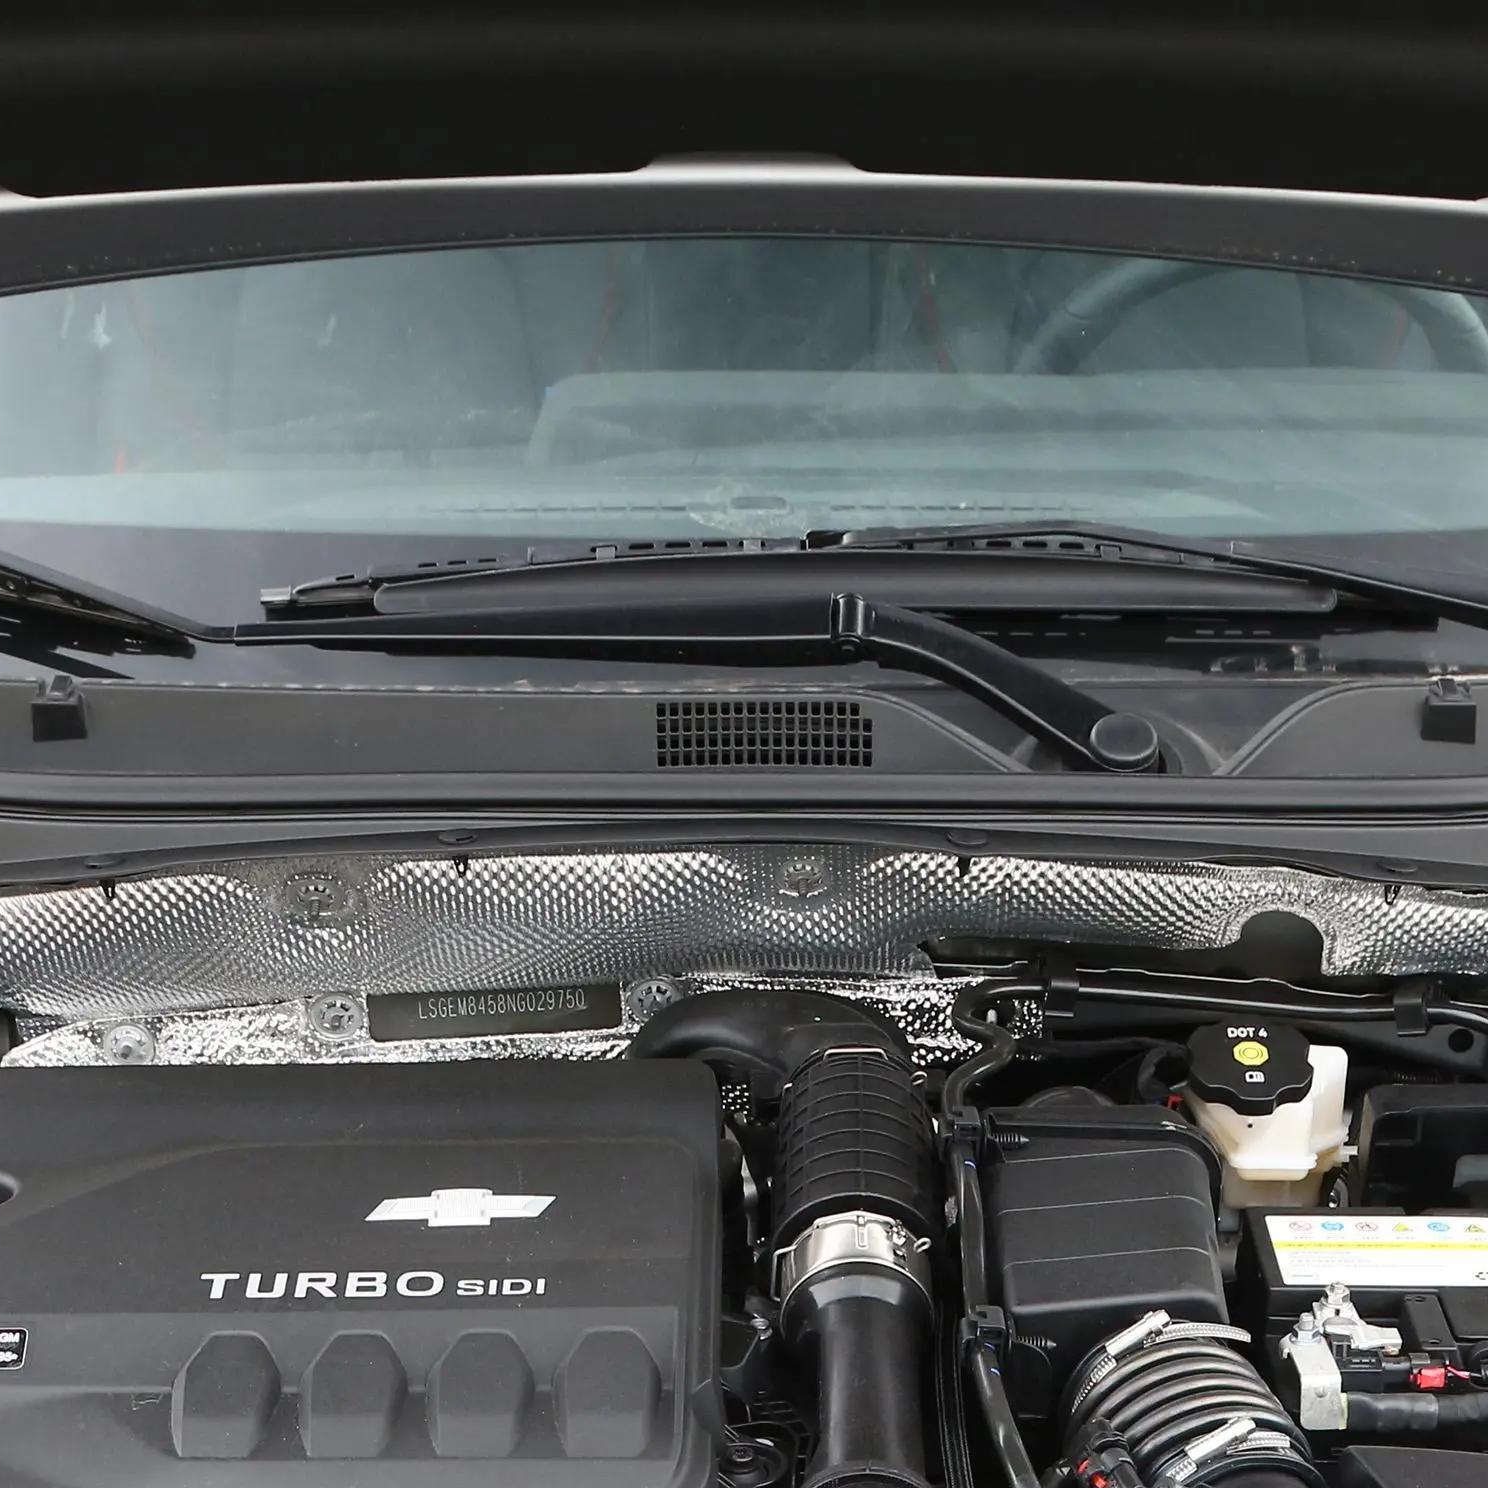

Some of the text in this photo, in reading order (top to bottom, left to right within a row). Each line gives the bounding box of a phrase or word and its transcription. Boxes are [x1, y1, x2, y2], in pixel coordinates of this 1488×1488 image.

[418, 988, 585, 1020] LSGEM8458NG029750
[1227, 1027, 1268, 1038] DOT 4
[200, 1270, 547, 1299] TURBO SIDI
